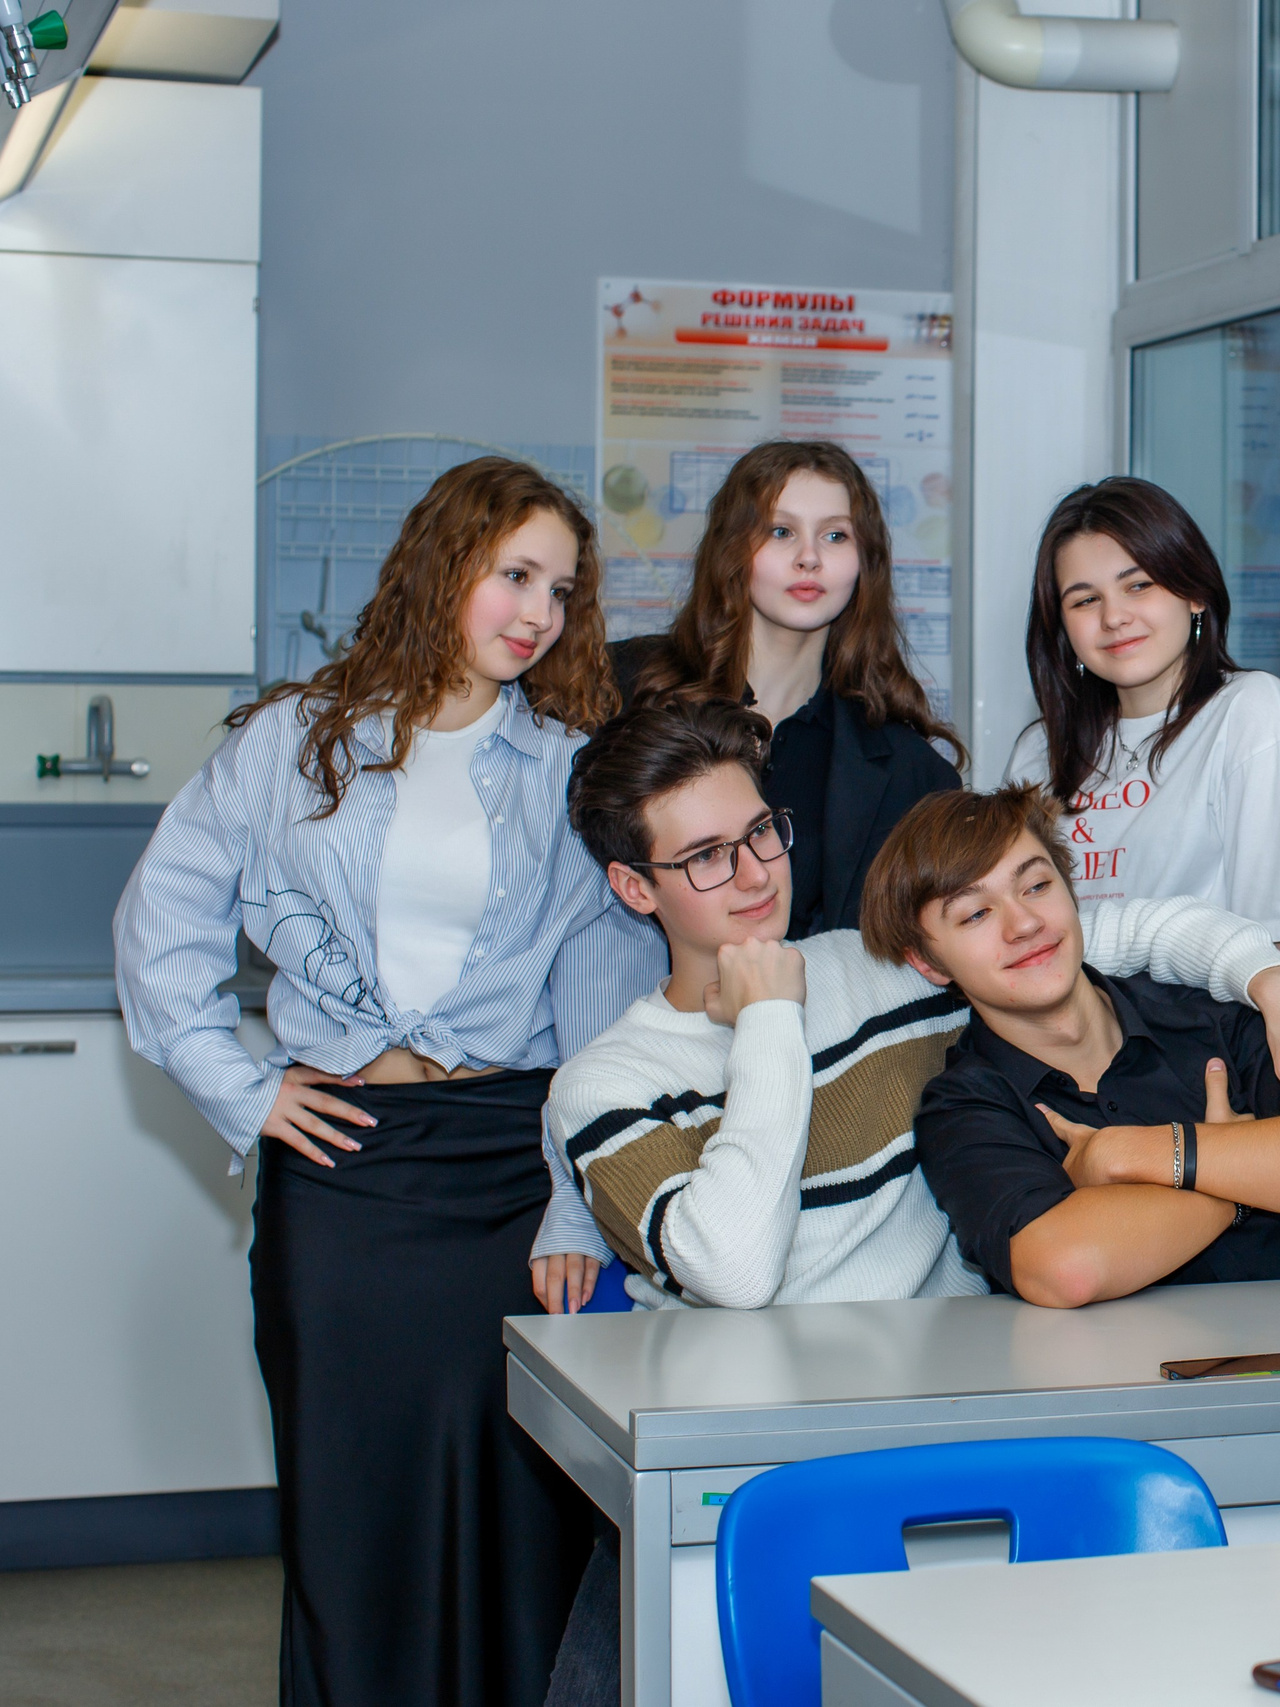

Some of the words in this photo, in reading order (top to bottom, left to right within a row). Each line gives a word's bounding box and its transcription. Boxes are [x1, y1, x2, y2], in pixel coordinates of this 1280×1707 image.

[712, 289, 855, 312] ФОРМУЛЫ
[701, 312, 793, 330] РЕШЕНИЯ
[798, 316, 866, 333] ЗАДАЧ
[1071, 817, 1096, 843] &
